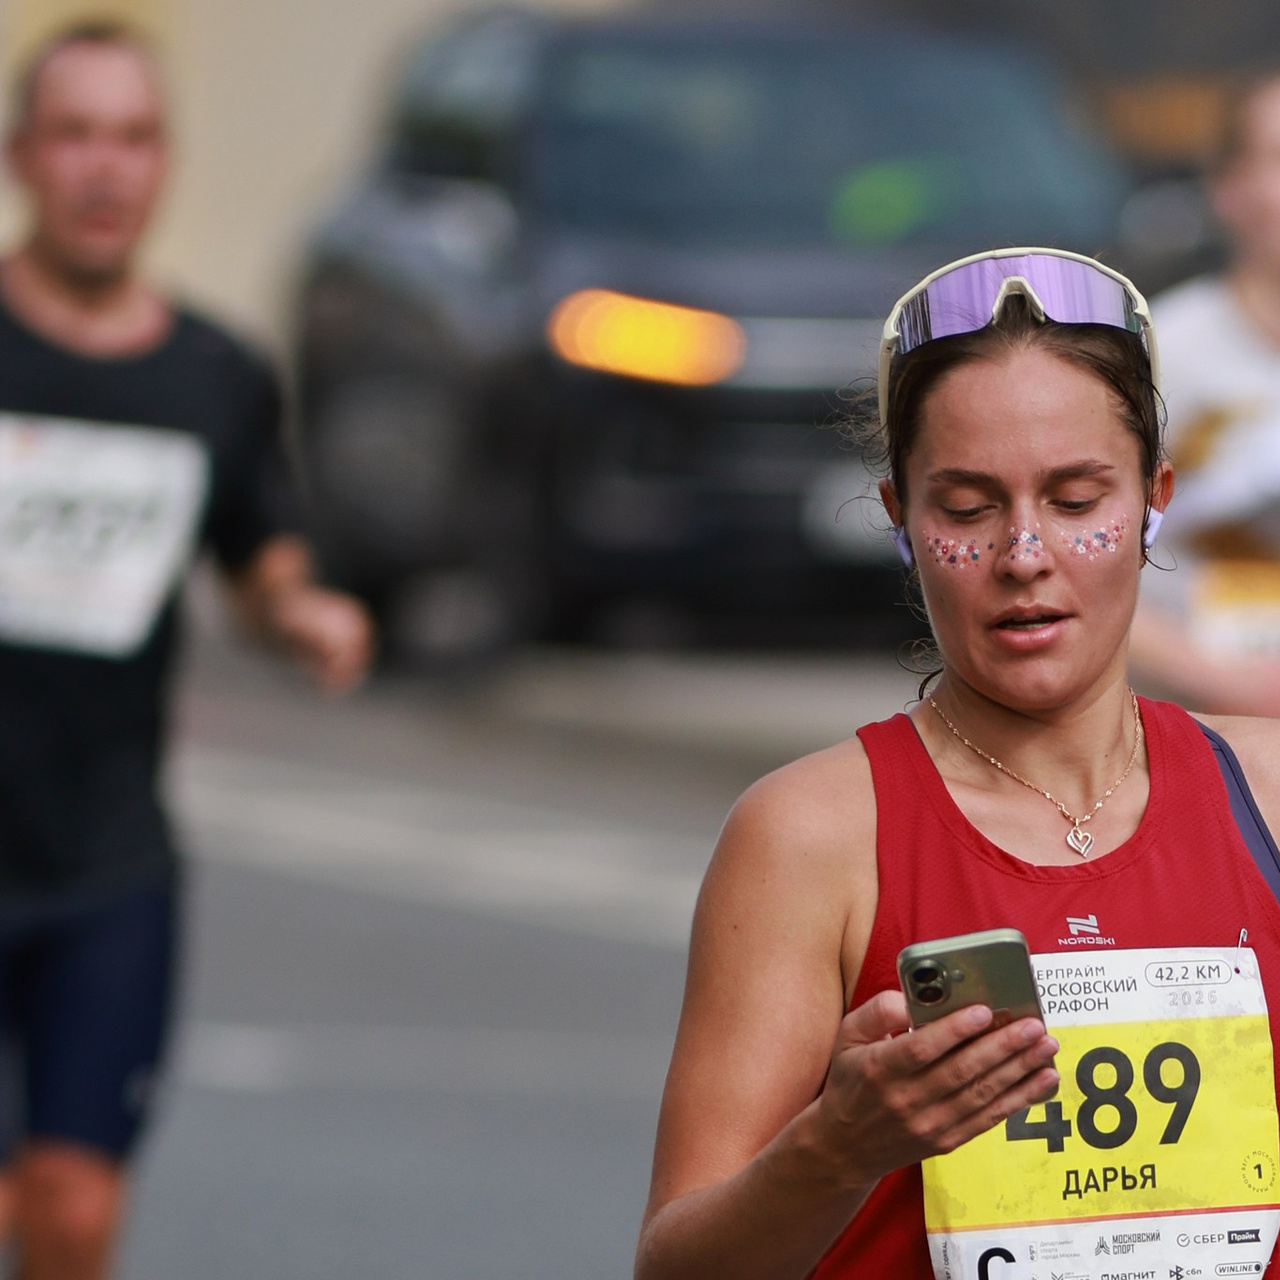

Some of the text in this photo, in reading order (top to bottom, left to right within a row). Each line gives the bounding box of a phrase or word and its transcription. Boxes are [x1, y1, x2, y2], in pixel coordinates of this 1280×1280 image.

[1058, 937, 1115, 945] NORDSKI
[1036, 965, 1105, 980] ЕРПРАЙМ
[1155, 965, 1221, 982] 42,2 КМ
[1038, 976, 1137, 997] ОСКОВСКИЙ
[1041, 997, 1109, 1014] РАФОН
[1169, 990, 1217, 1006] 2026
[1006, 1042, 1201, 1153] 489
[1253, 1163, 1263, 1179] 1
[1062, 1164, 1157, 1200] ДАРЬЯ
[1112, 1230, 1161, 1244] МОСКОВСКИЙ
[1193, 1233, 1256, 1244] СБЕР Прайм
[1113, 1244, 1135, 1255] СПОРТ
[1218, 1265, 1253, 1273] WINLINE
